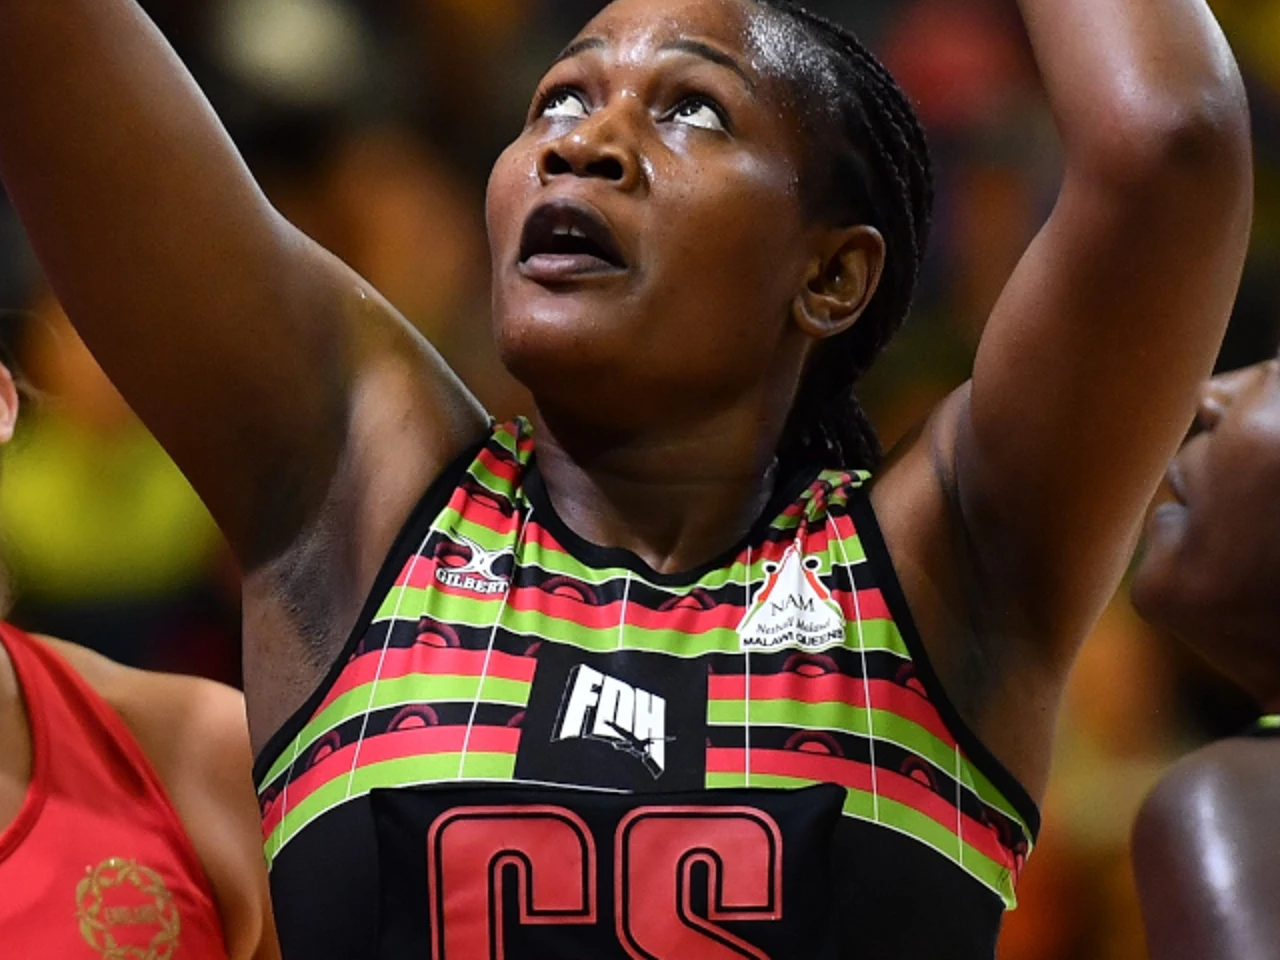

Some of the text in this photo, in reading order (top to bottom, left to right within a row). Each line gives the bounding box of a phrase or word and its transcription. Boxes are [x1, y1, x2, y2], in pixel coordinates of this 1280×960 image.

[435, 568, 508, 594] GILBERT
[770, 594, 815, 616] NAM
[796, 629, 843, 646] QUEENS
[559, 663, 666, 773] FDH
